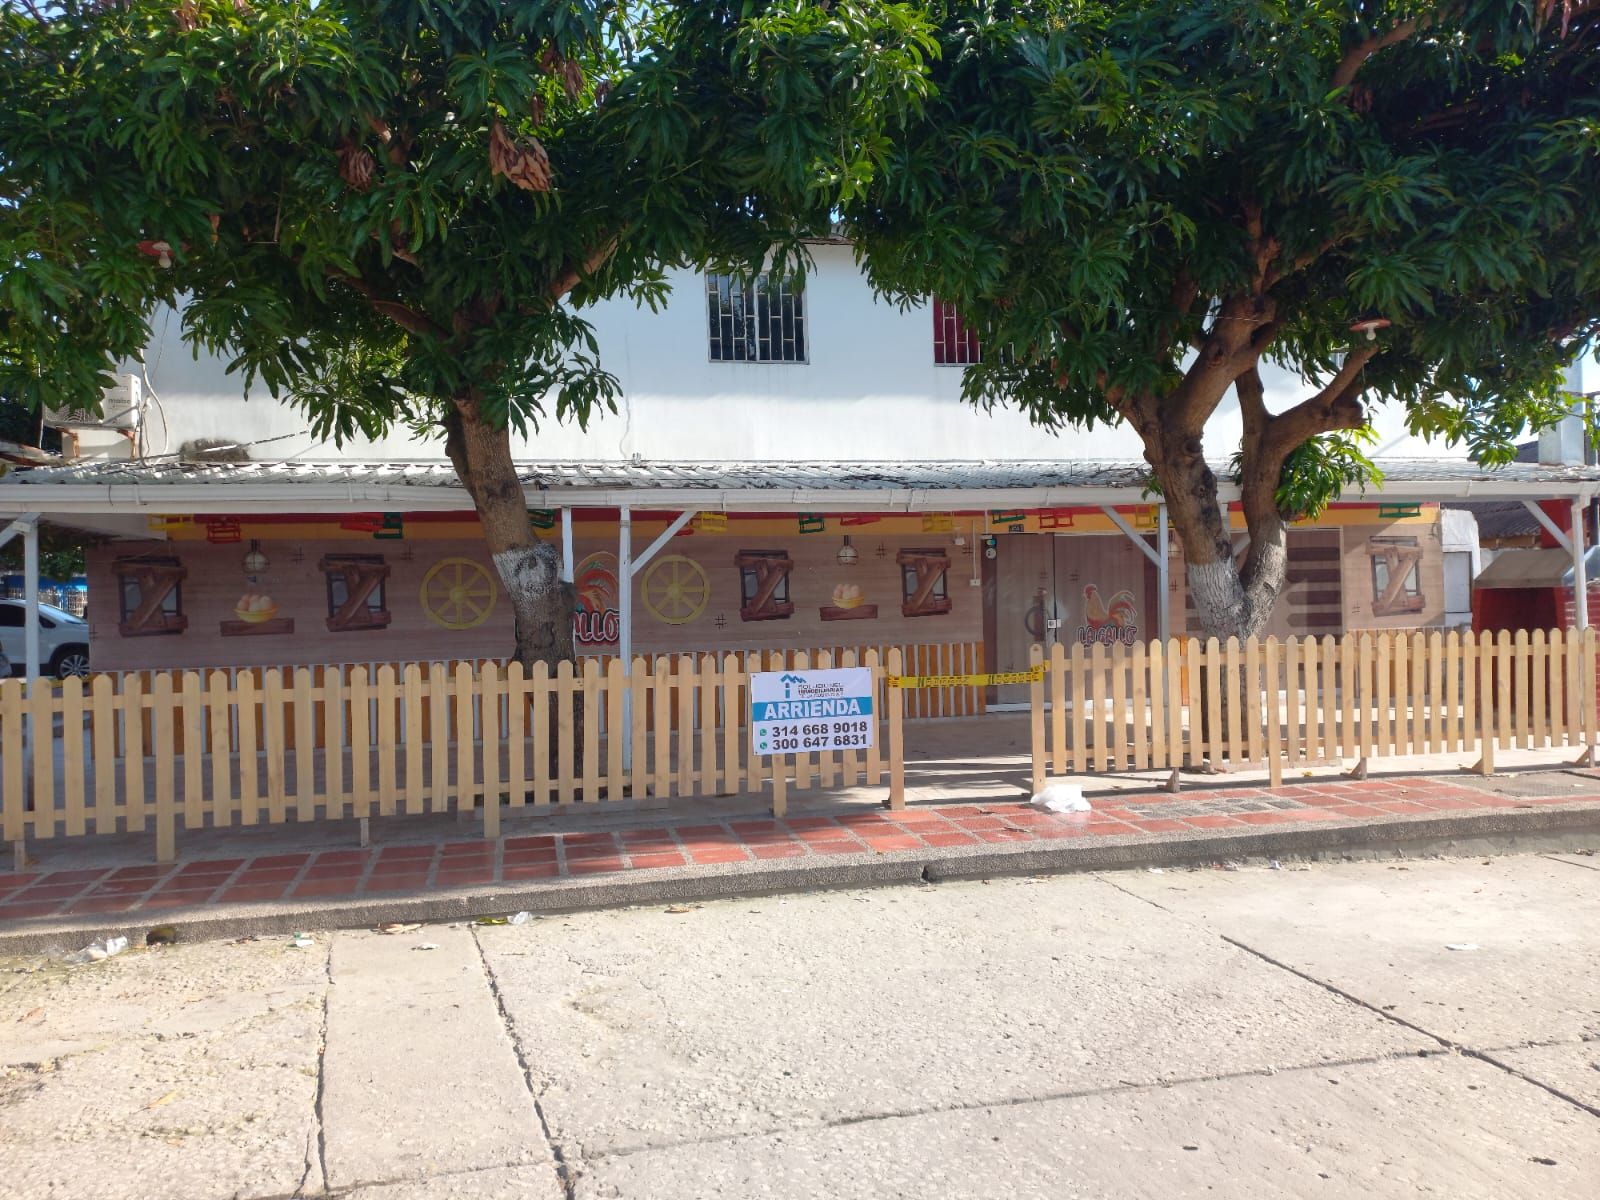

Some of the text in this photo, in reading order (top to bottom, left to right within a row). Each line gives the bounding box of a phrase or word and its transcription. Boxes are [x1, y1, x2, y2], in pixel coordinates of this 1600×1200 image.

[573, 609, 620, 642] LLO
[1095, 625, 1137, 646] GALLO
[764, 699, 861, 720] ARRIENDA
[772, 722, 867, 737] 314 668 9018
[772, 734, 867, 750] 300 647 6831
